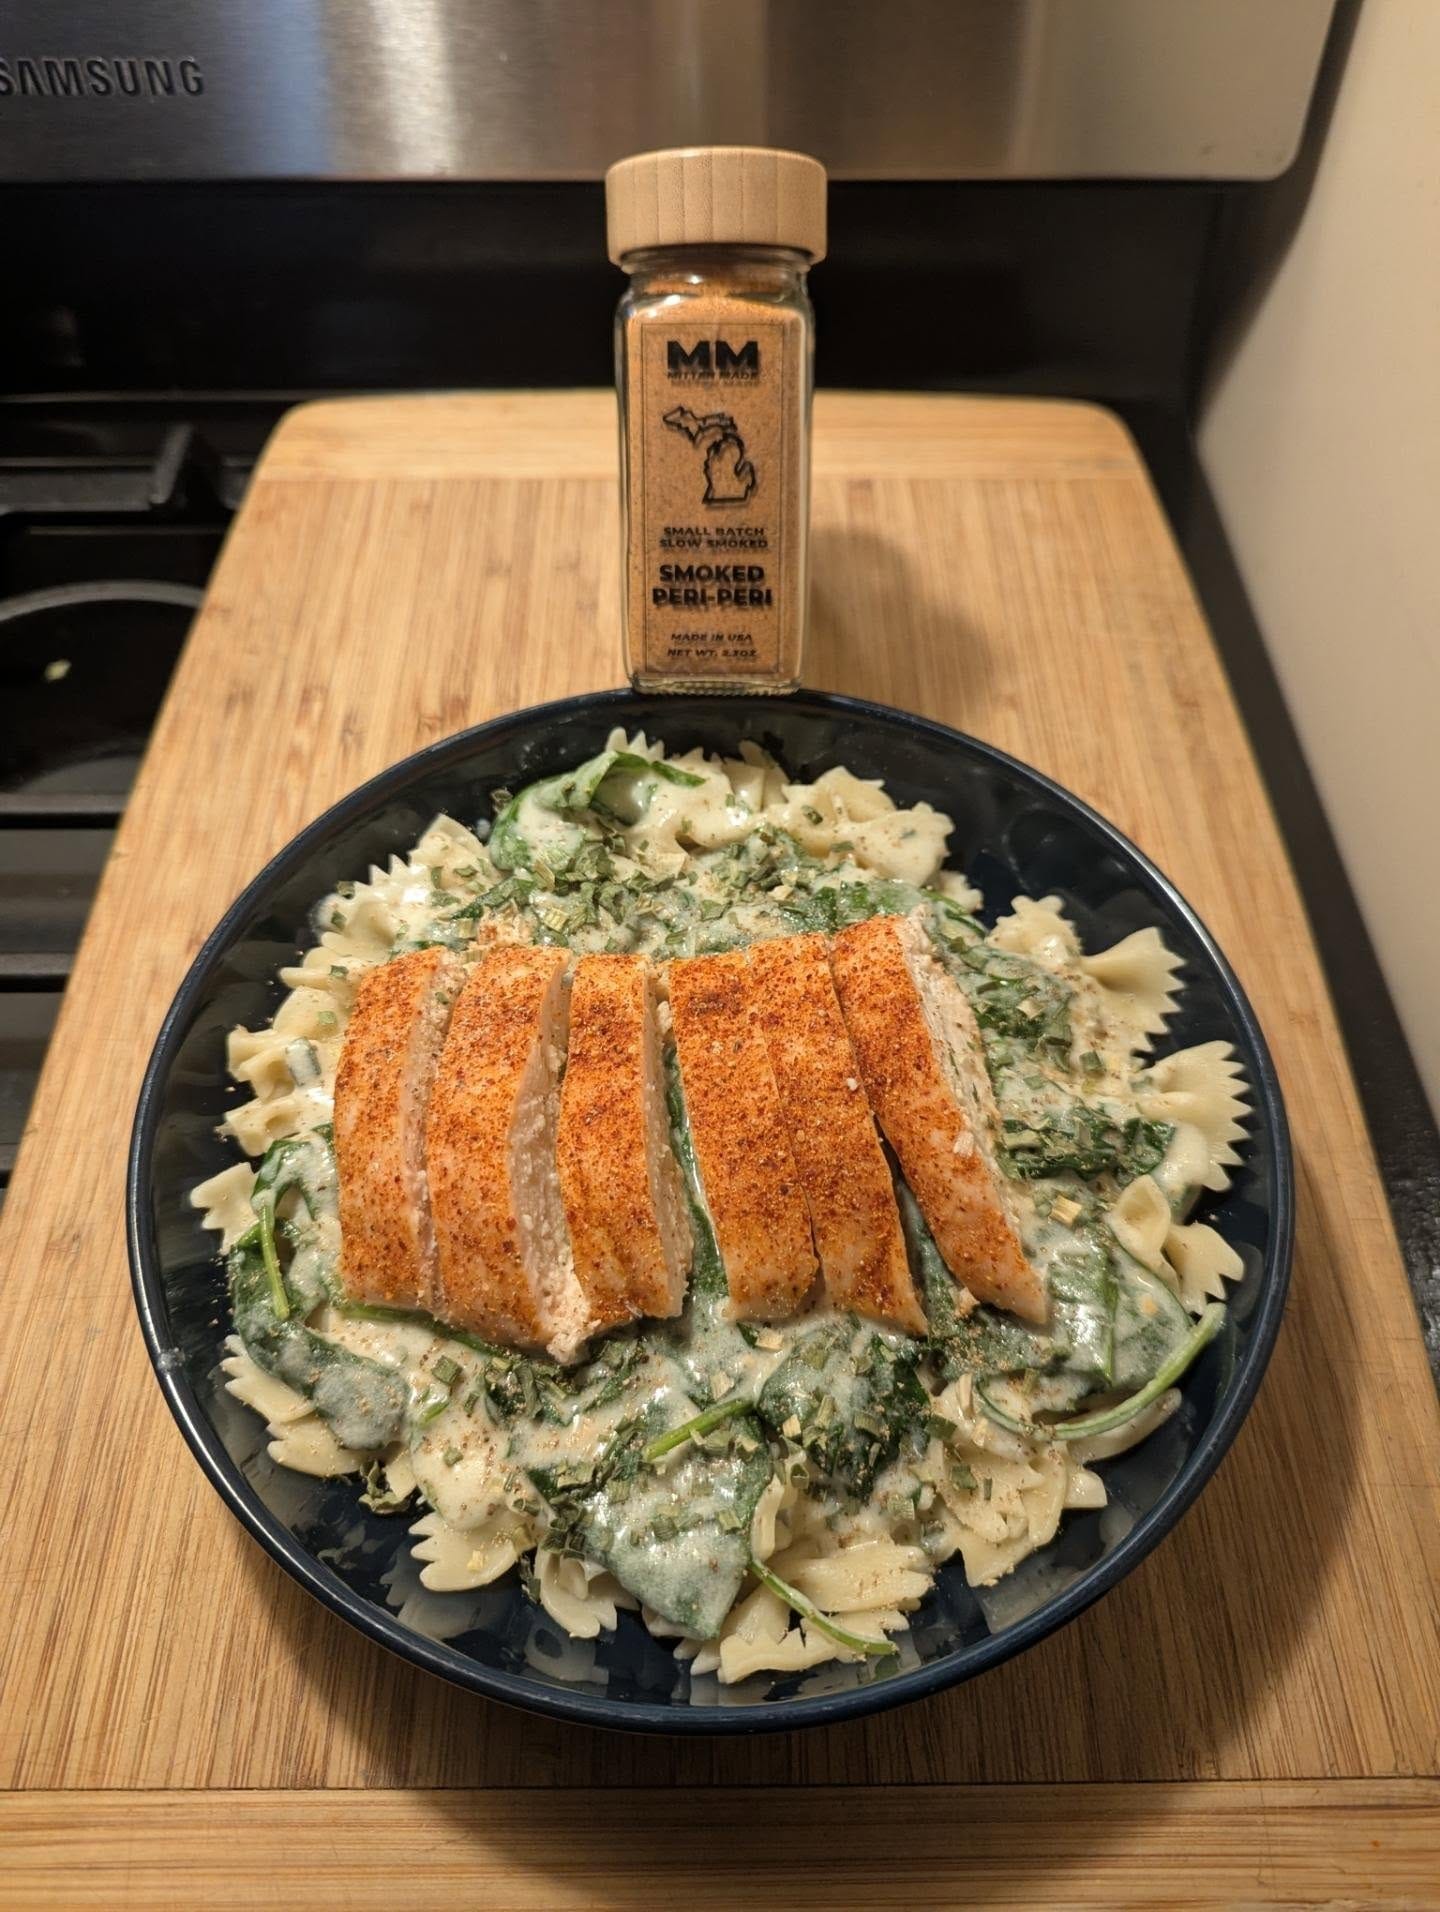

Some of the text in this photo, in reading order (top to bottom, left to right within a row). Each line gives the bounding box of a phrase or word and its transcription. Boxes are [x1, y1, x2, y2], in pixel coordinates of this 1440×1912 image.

[0, 58, 204, 97] SAMSUNG
[667, 340, 758, 370] MM
[664, 527, 765, 536] SMALL BATCH
[660, 539, 768, 548] SLOW SMOKED
[659, 564, 765, 582] SMOKED
[653, 588, 772, 606] PERI-PERI
[671, 633, 752, 641] MADE IN USA
[667, 649, 690, 657] NET
[696, 649, 718, 657] WT.
